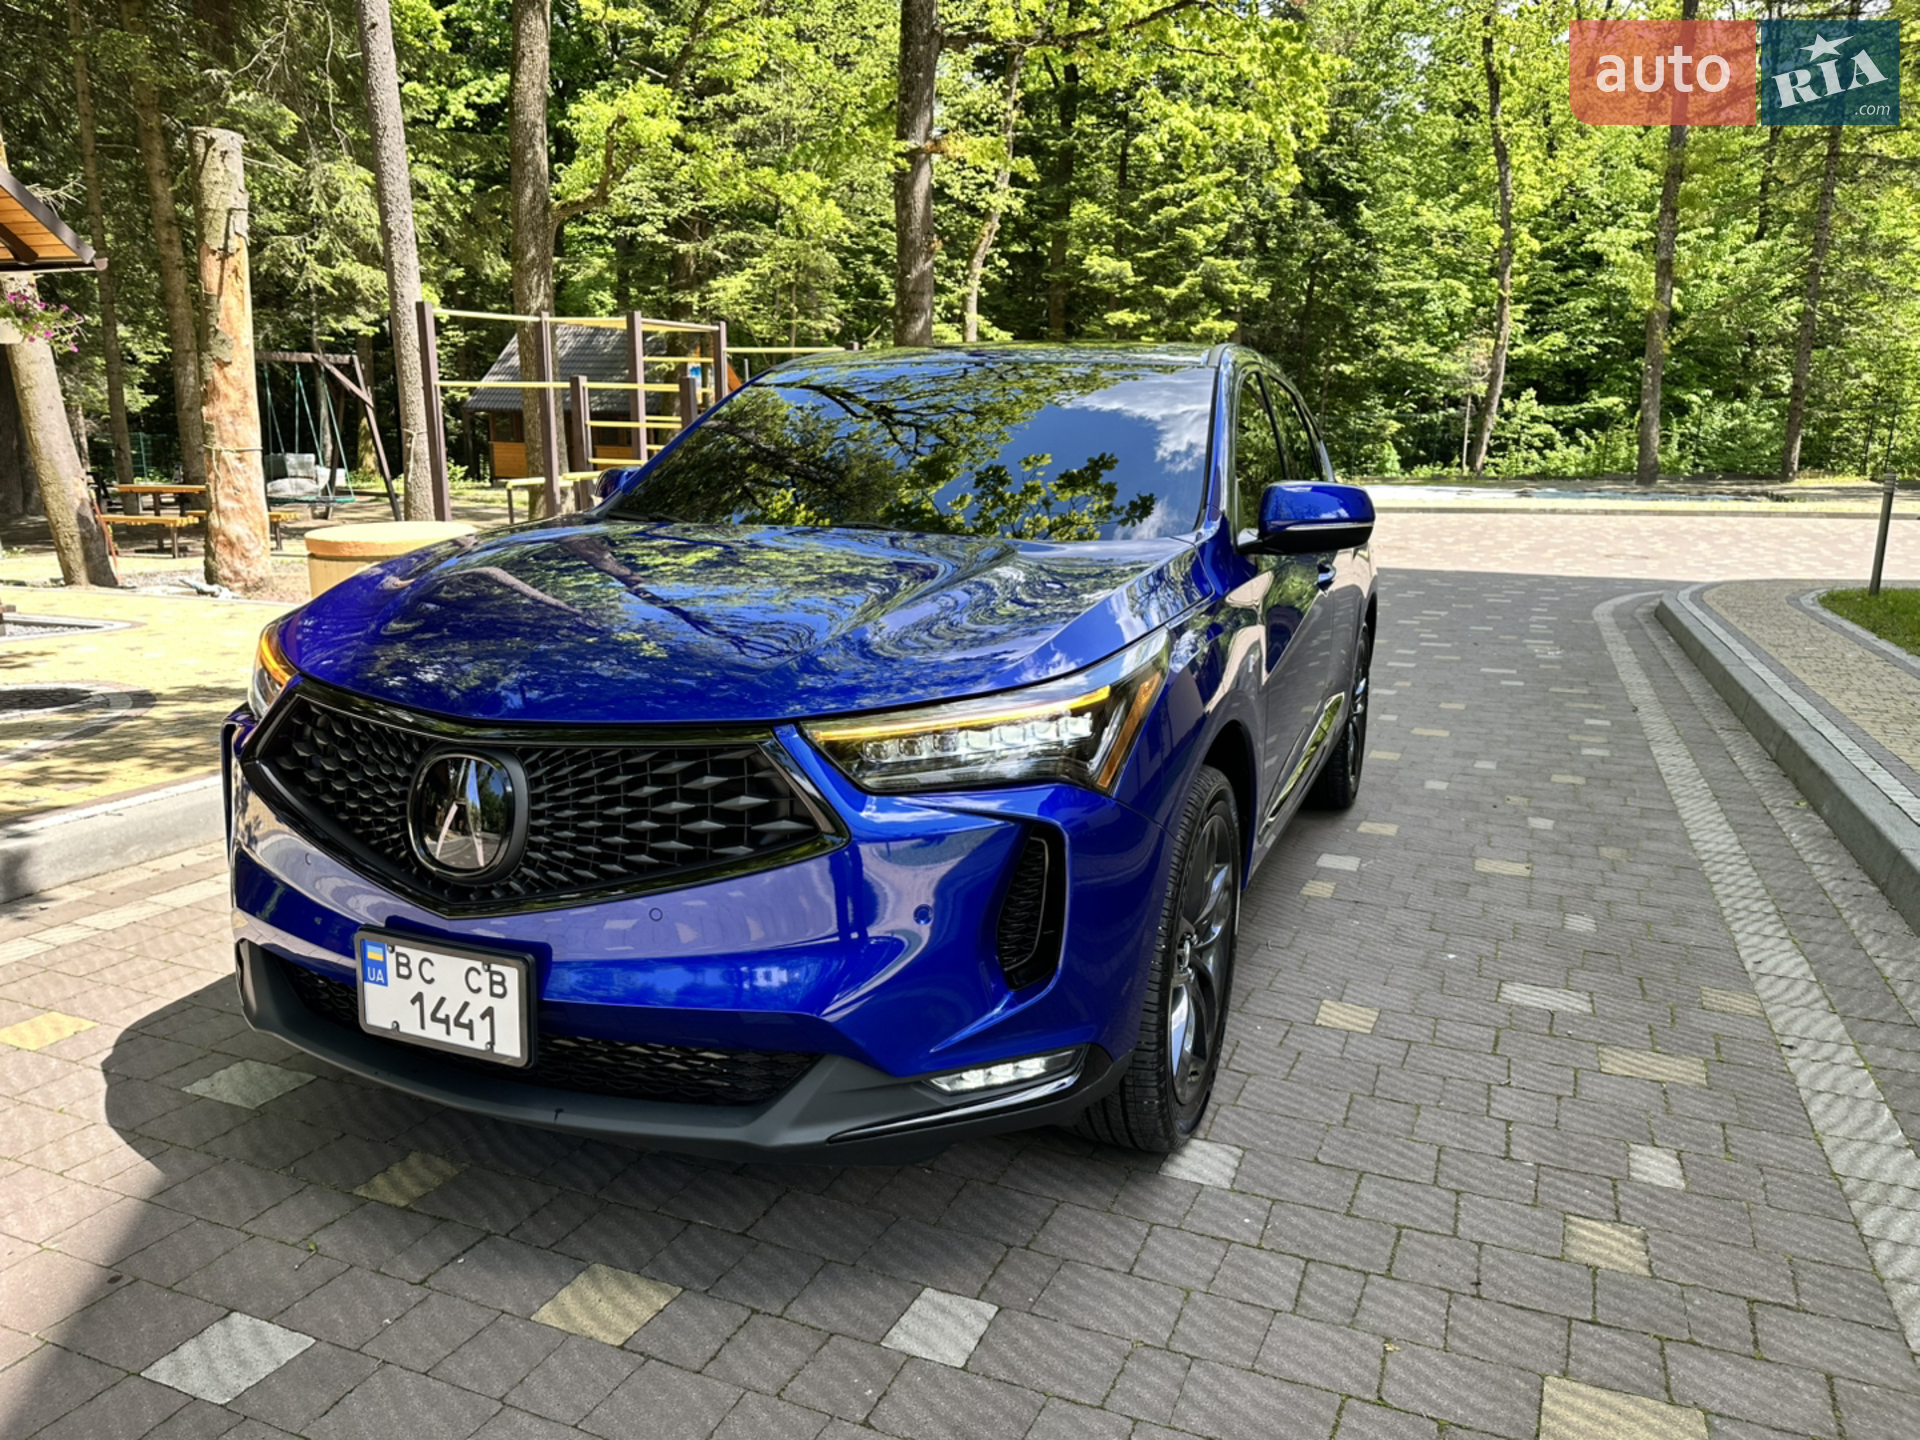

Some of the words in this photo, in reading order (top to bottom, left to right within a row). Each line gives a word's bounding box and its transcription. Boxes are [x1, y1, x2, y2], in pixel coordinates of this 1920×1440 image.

[367, 966, 385, 983] UA
[396, 952, 435, 985] BC
[465, 966, 508, 999] CB
[410, 991, 495, 1046] 1441
